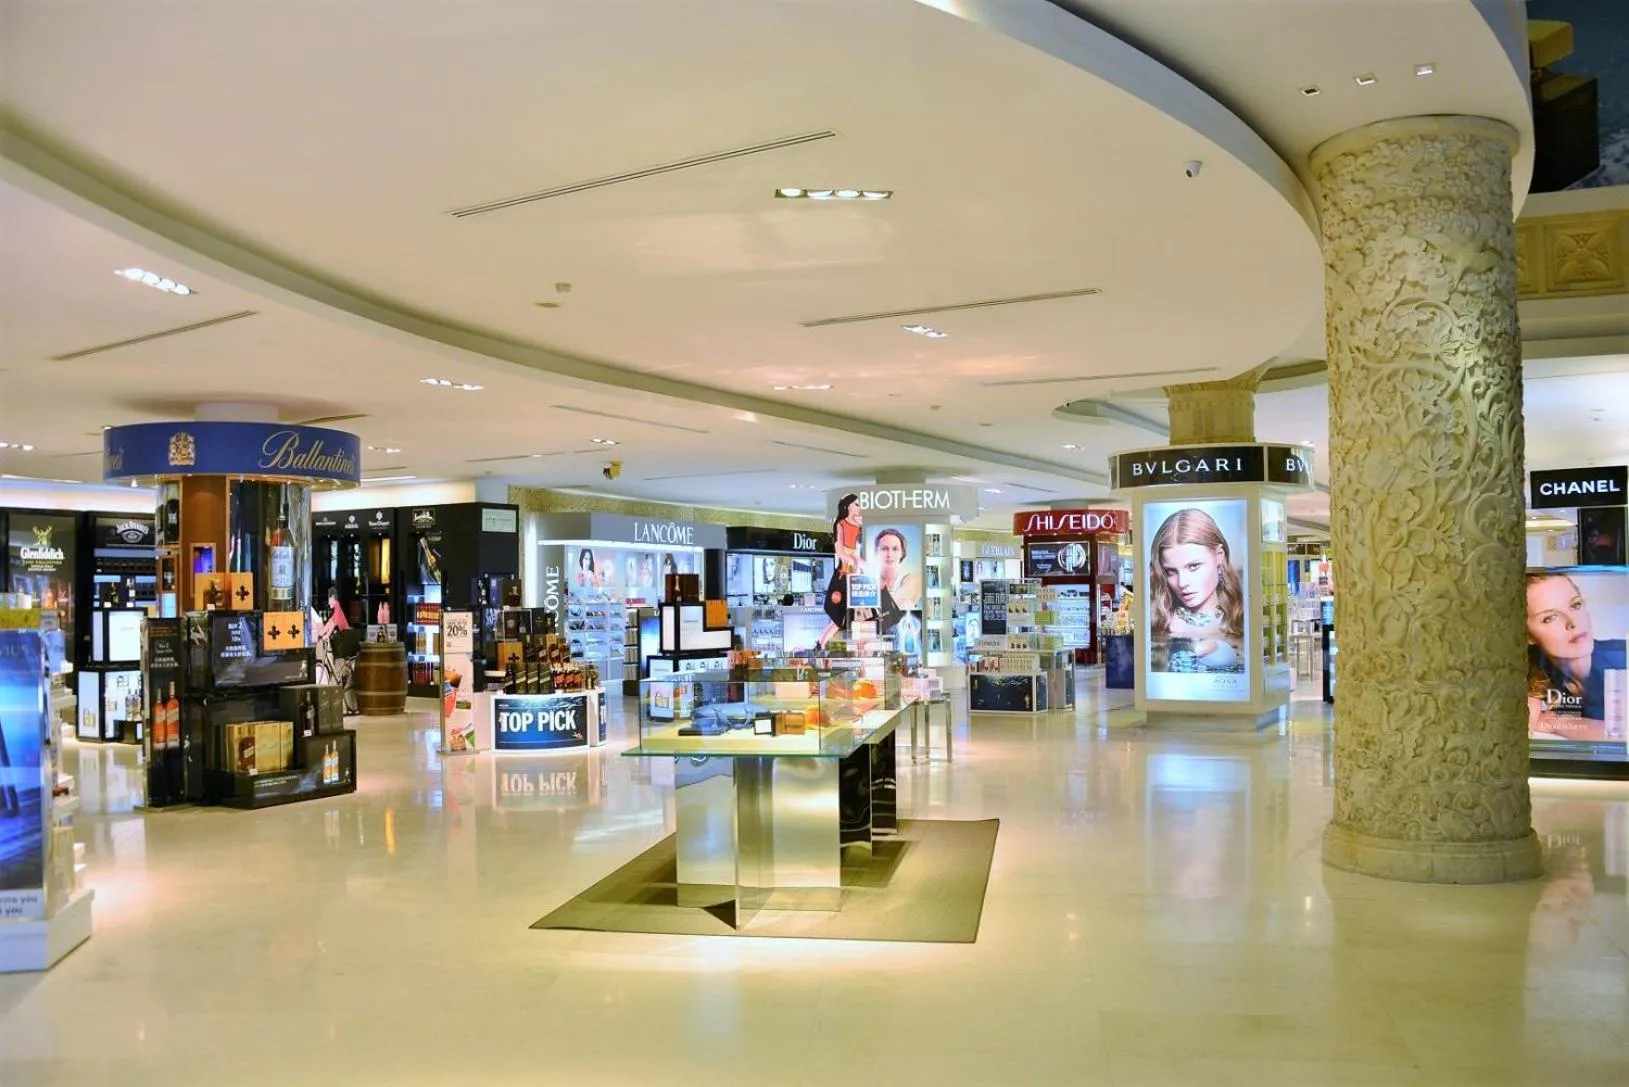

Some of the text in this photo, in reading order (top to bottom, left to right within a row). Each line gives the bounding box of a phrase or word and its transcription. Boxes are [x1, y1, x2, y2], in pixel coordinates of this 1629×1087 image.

[1132, 457, 1243, 477] BVLGARI
[1539, 479, 1621, 496] CHANEL
[859, 489, 950, 510] BIOTHERM
[1023, 513, 1114, 532] SHISEIDO
[634, 521, 694, 545] LANCÔME
[793, 532, 817, 550] Dior
[1547, 688, 1582, 705] Dior
[499, 709, 577, 733] TOP PICK
